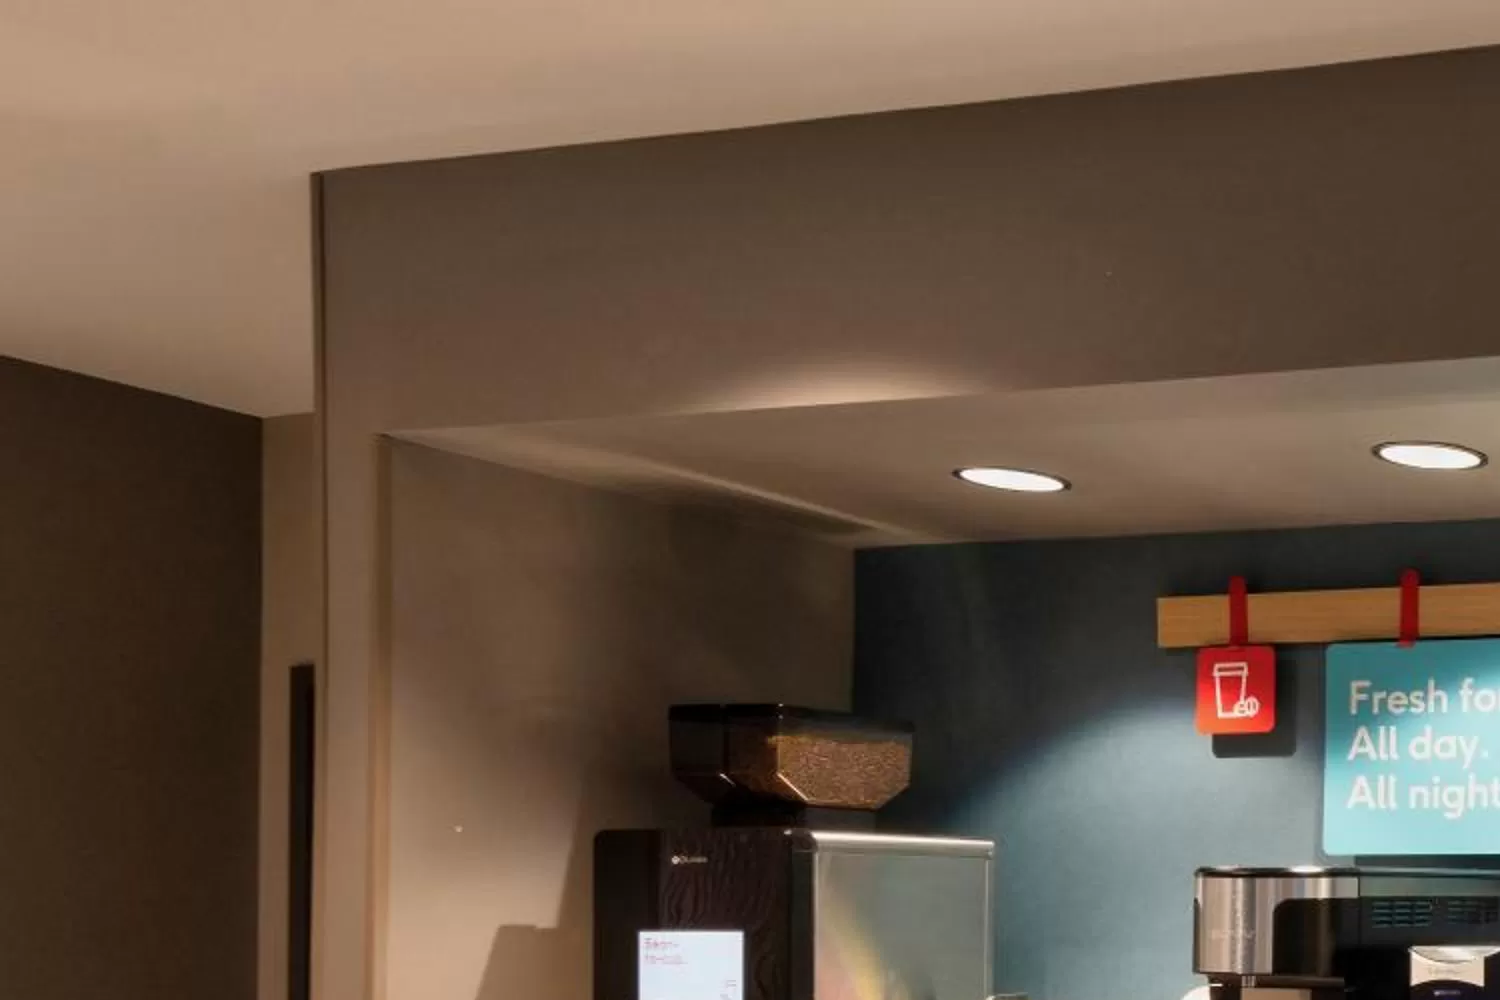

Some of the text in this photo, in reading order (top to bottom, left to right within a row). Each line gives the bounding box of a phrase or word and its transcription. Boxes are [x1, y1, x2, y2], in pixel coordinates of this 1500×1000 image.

[1349, 677, 1449, 715] Fresh
[1347, 723, 1489, 769] All day.
[1347, 773, 1399, 810] All
